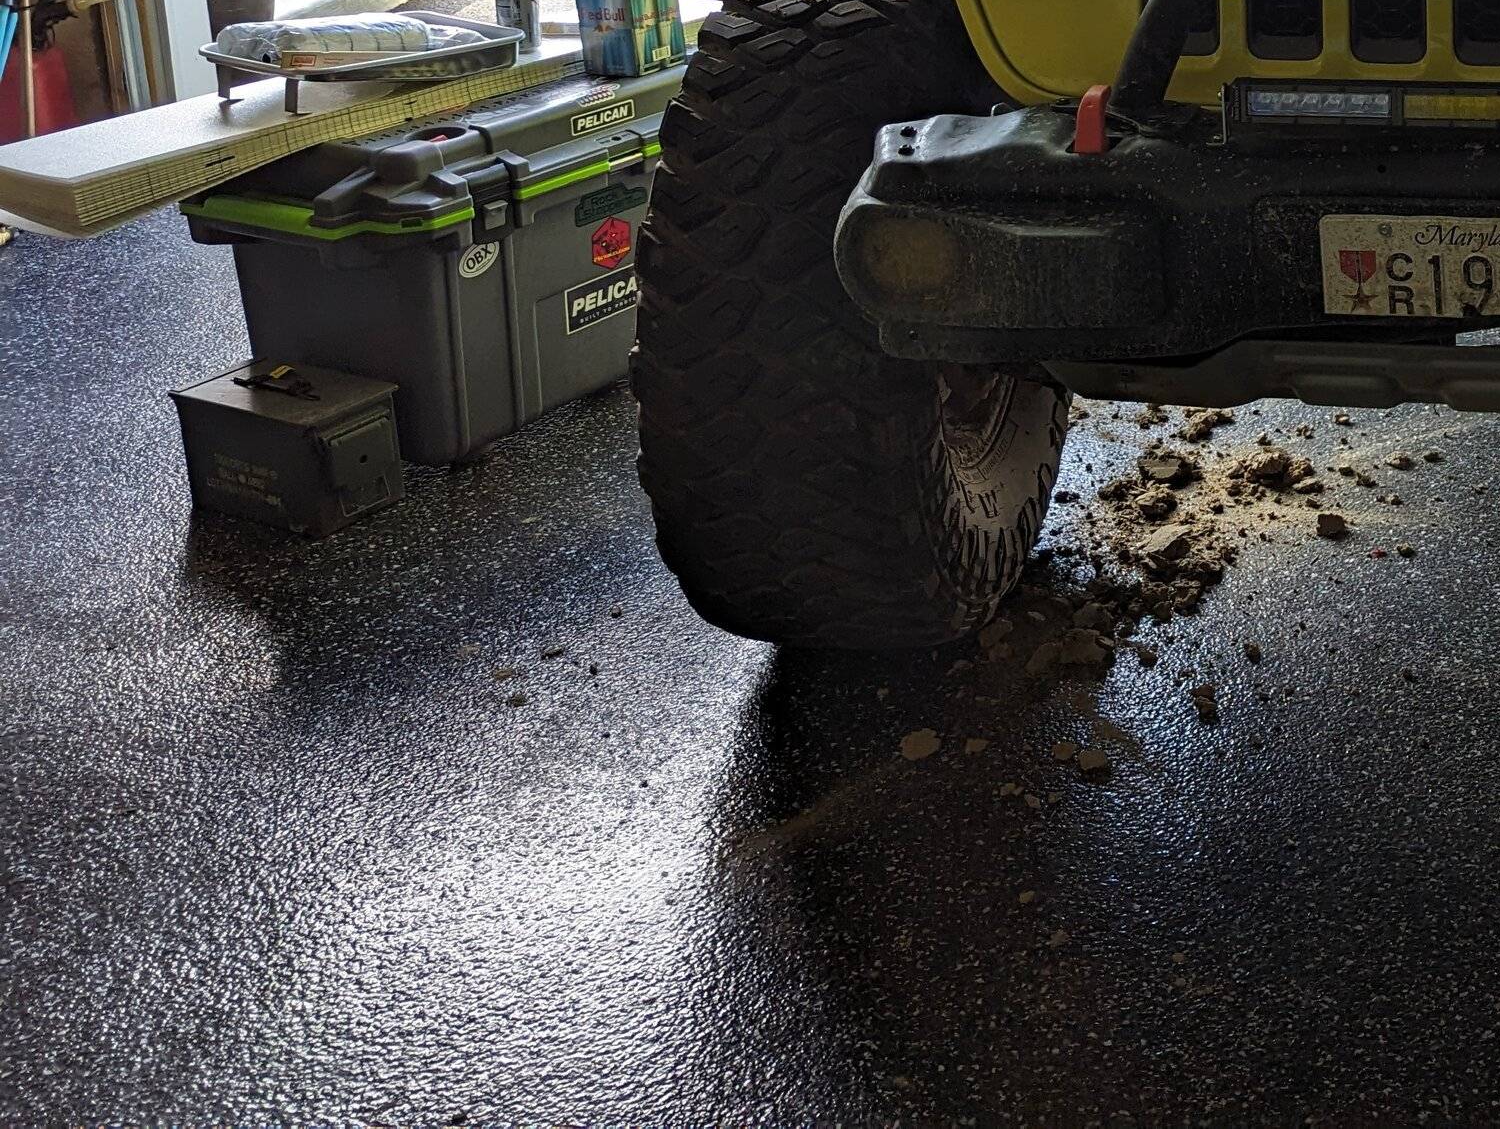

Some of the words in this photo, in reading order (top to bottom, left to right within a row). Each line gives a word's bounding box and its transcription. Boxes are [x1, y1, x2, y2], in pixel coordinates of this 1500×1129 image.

[577, 104, 629, 131] PELICAN
[465, 243, 494, 270] OBX
[572, 276, 638, 318] PELICA
